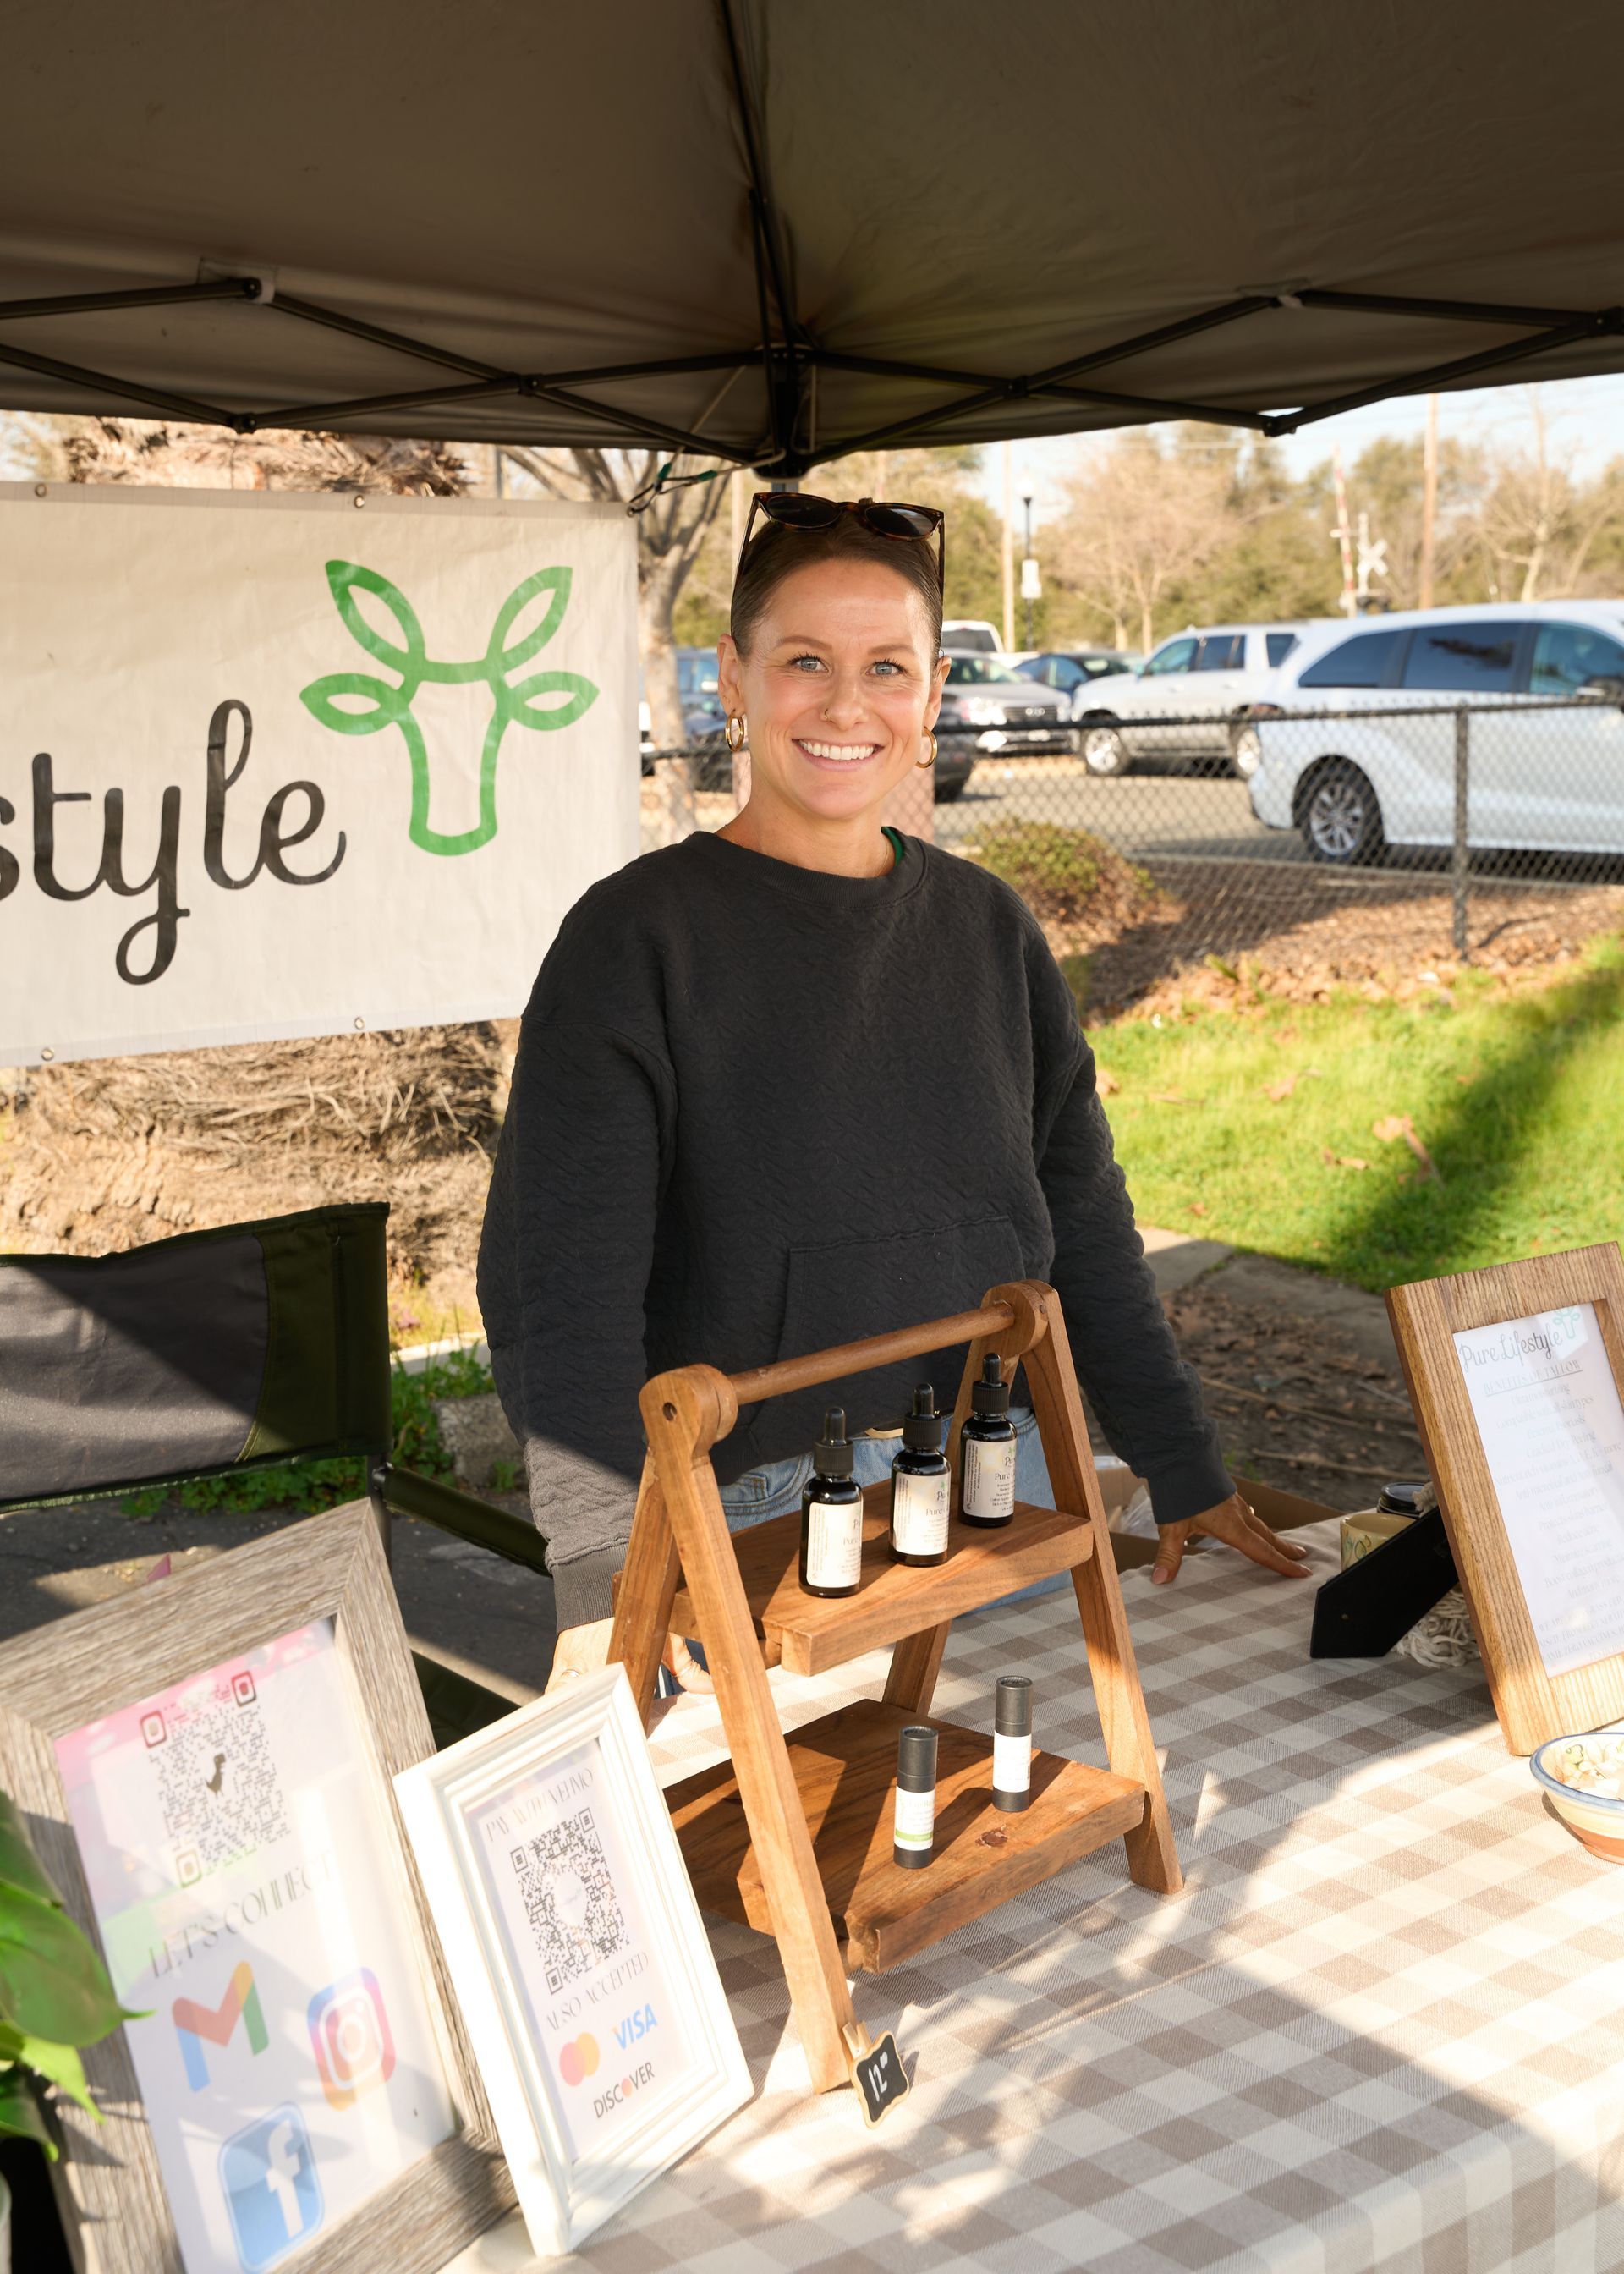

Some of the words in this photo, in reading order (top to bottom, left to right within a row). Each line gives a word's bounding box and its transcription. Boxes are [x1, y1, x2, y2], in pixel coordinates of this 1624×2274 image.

[1459, 1343, 1498, 1373] Pure
[1499, 1323, 1563, 1366] Lifestyle
[585, 1951, 650, 2005] ACCEPTED
[610, 2002, 659, 2050] VISA
[593, 2061, 656, 2119] DISCOVER
